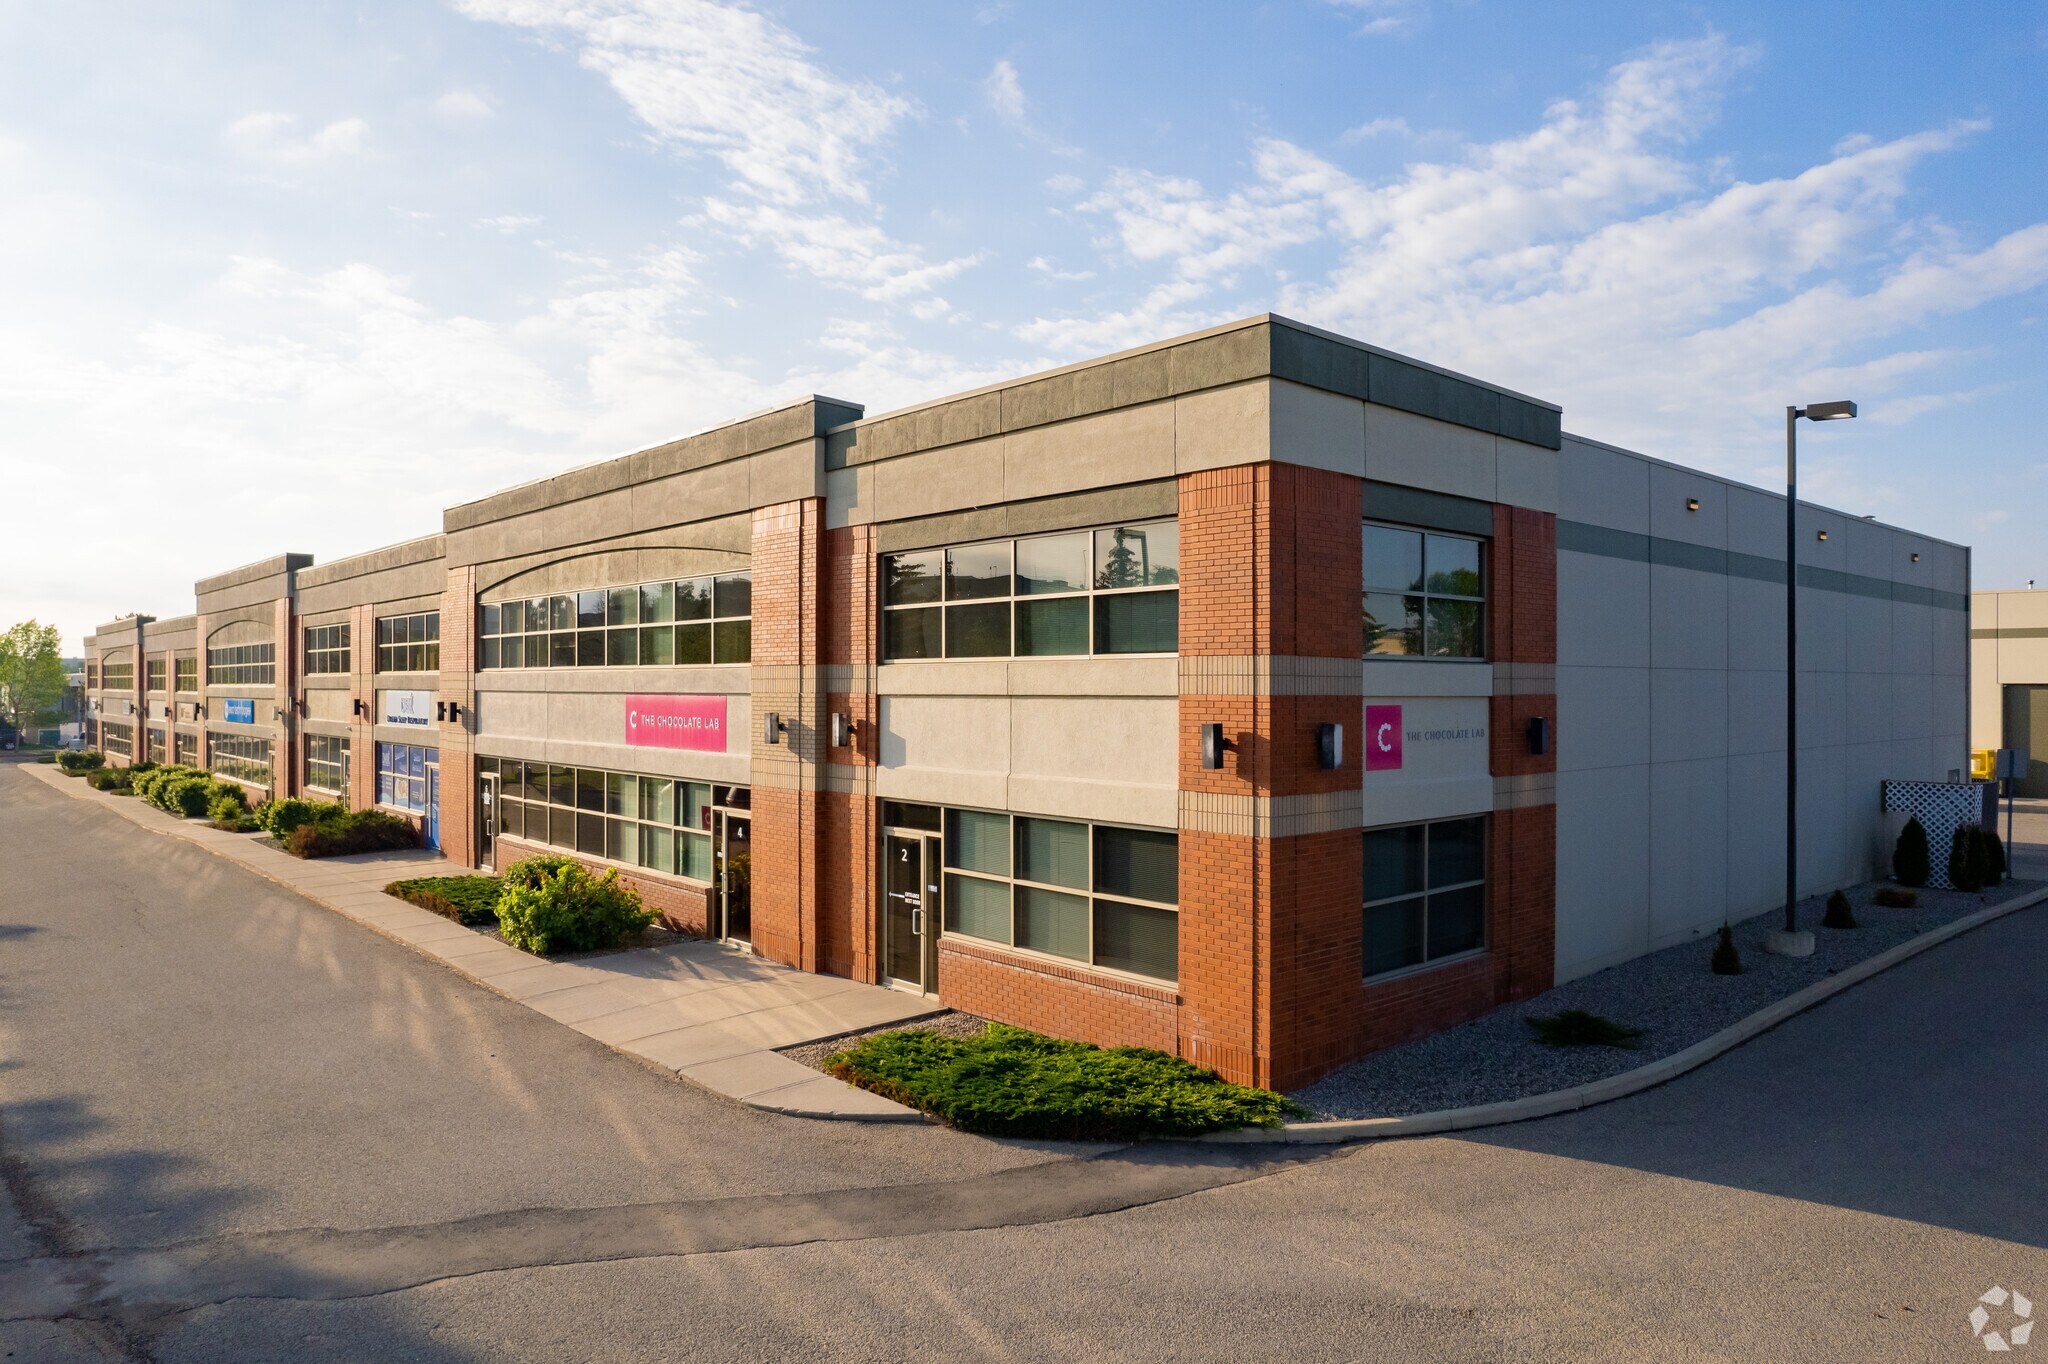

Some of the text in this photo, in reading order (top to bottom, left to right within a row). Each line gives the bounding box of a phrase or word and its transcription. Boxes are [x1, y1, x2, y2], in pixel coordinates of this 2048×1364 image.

[629, 710, 637, 728] C
[641, 714, 720, 729] THE CHOCOLATE LAB
[1378, 723, 1391, 752] C
[1407, 728, 1485, 741] THE CHOCOLATE LAB
[737, 826, 743, 838] 4
[901, 848, 908, 862] 2
